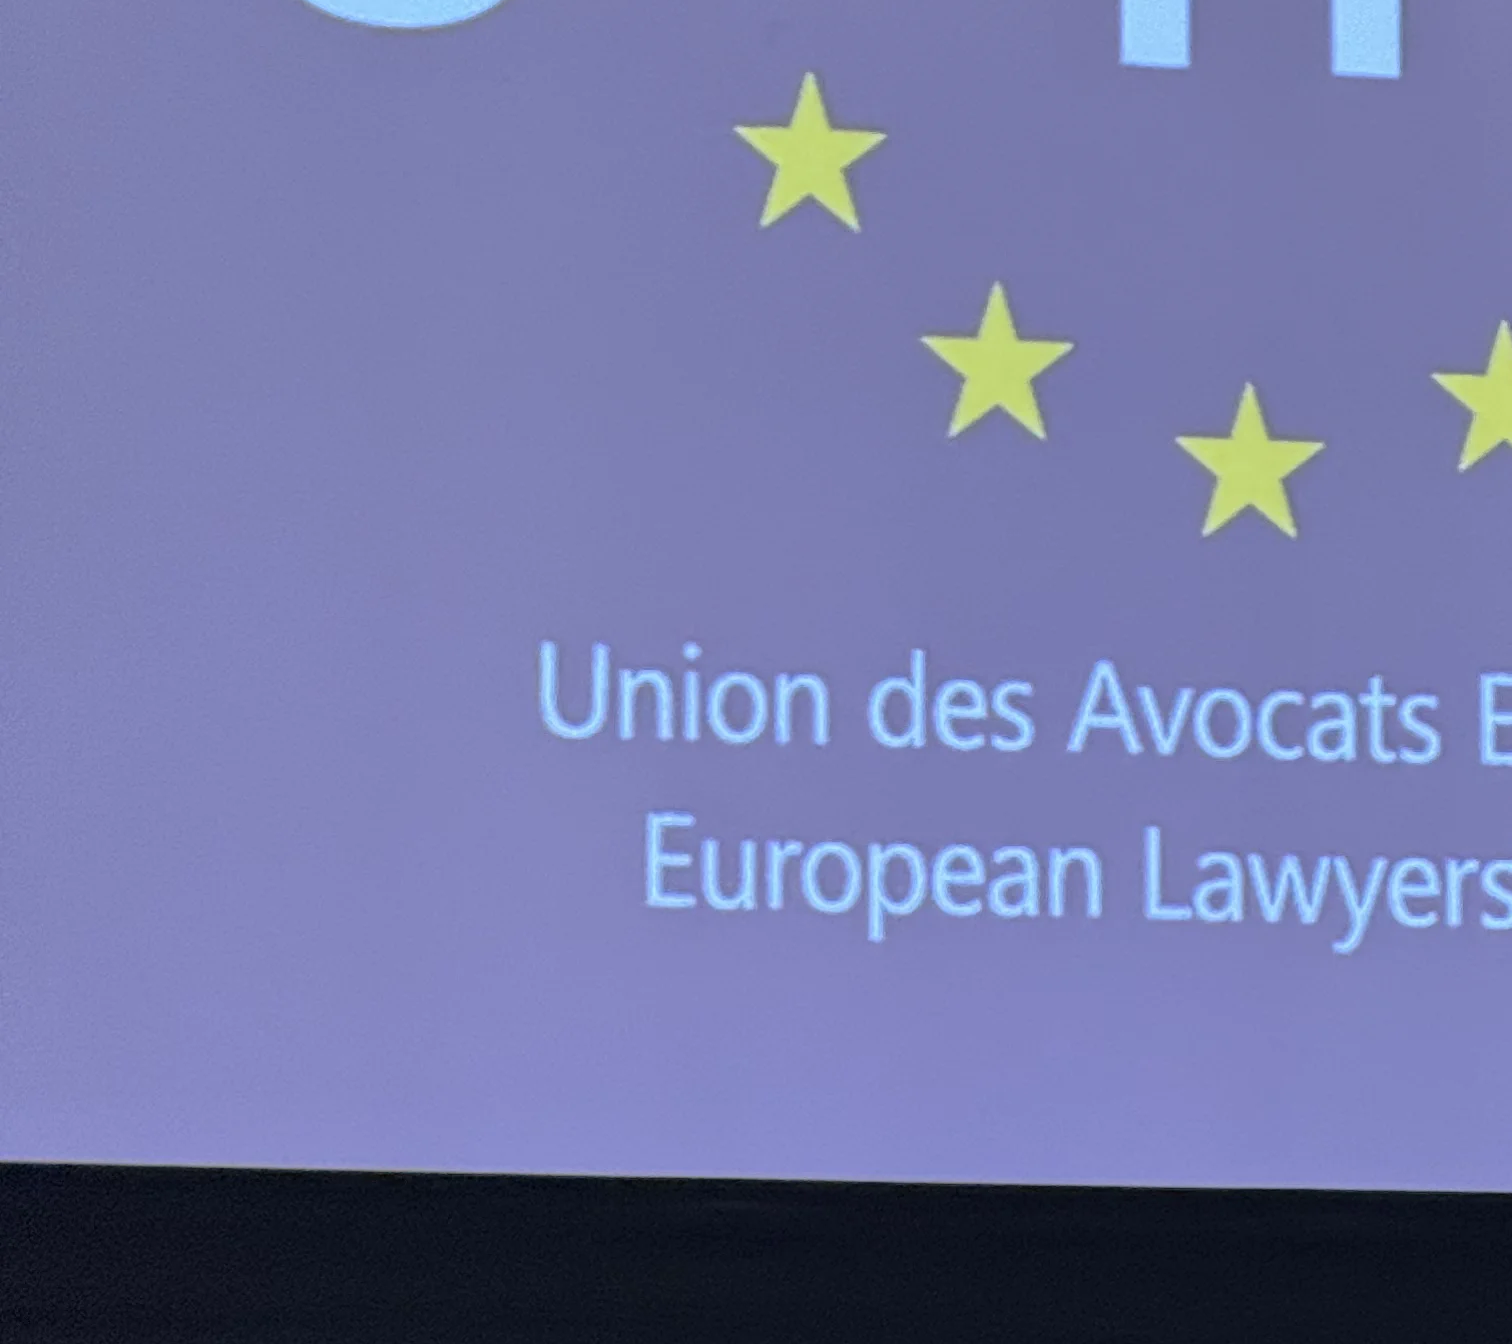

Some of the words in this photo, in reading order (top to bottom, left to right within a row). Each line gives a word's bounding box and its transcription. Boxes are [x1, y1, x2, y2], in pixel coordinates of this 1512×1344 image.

[537, 640, 831, 747] Union
[865, 647, 1037, 754] des
[1065, 659, 1443, 766] Avocats
[644, 810, 1104, 944] European
